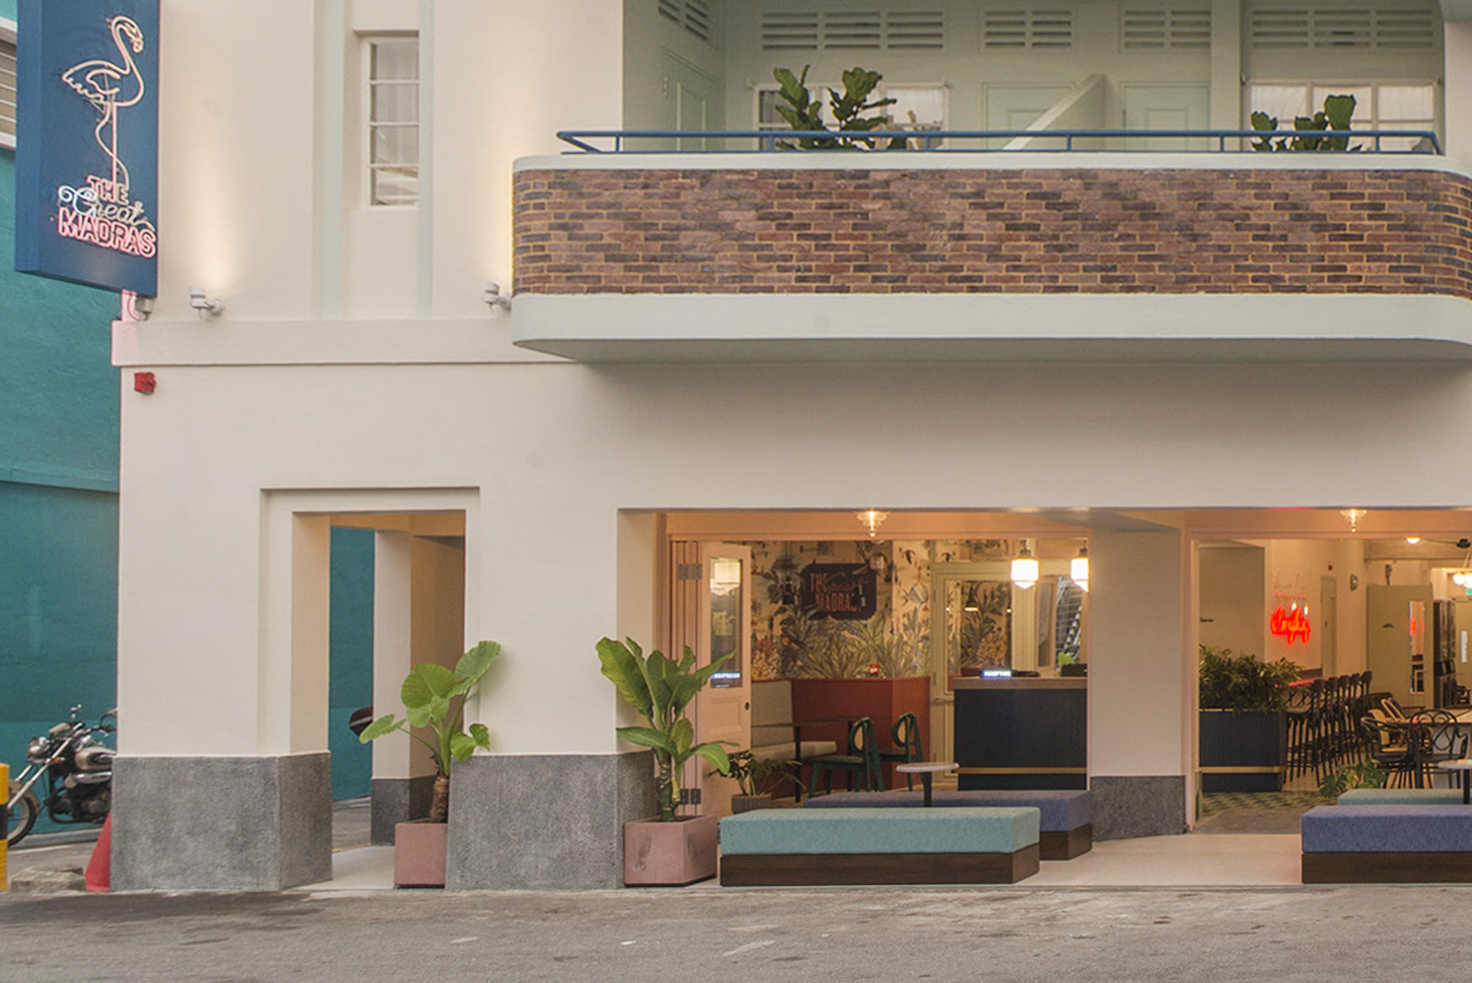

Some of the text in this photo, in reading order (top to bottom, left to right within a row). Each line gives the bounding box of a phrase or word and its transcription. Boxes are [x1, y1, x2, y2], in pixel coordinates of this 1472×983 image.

[58, 185, 155, 232] Great
[87, 174, 129, 205] THE
[58, 206, 156, 258] MADRAS
